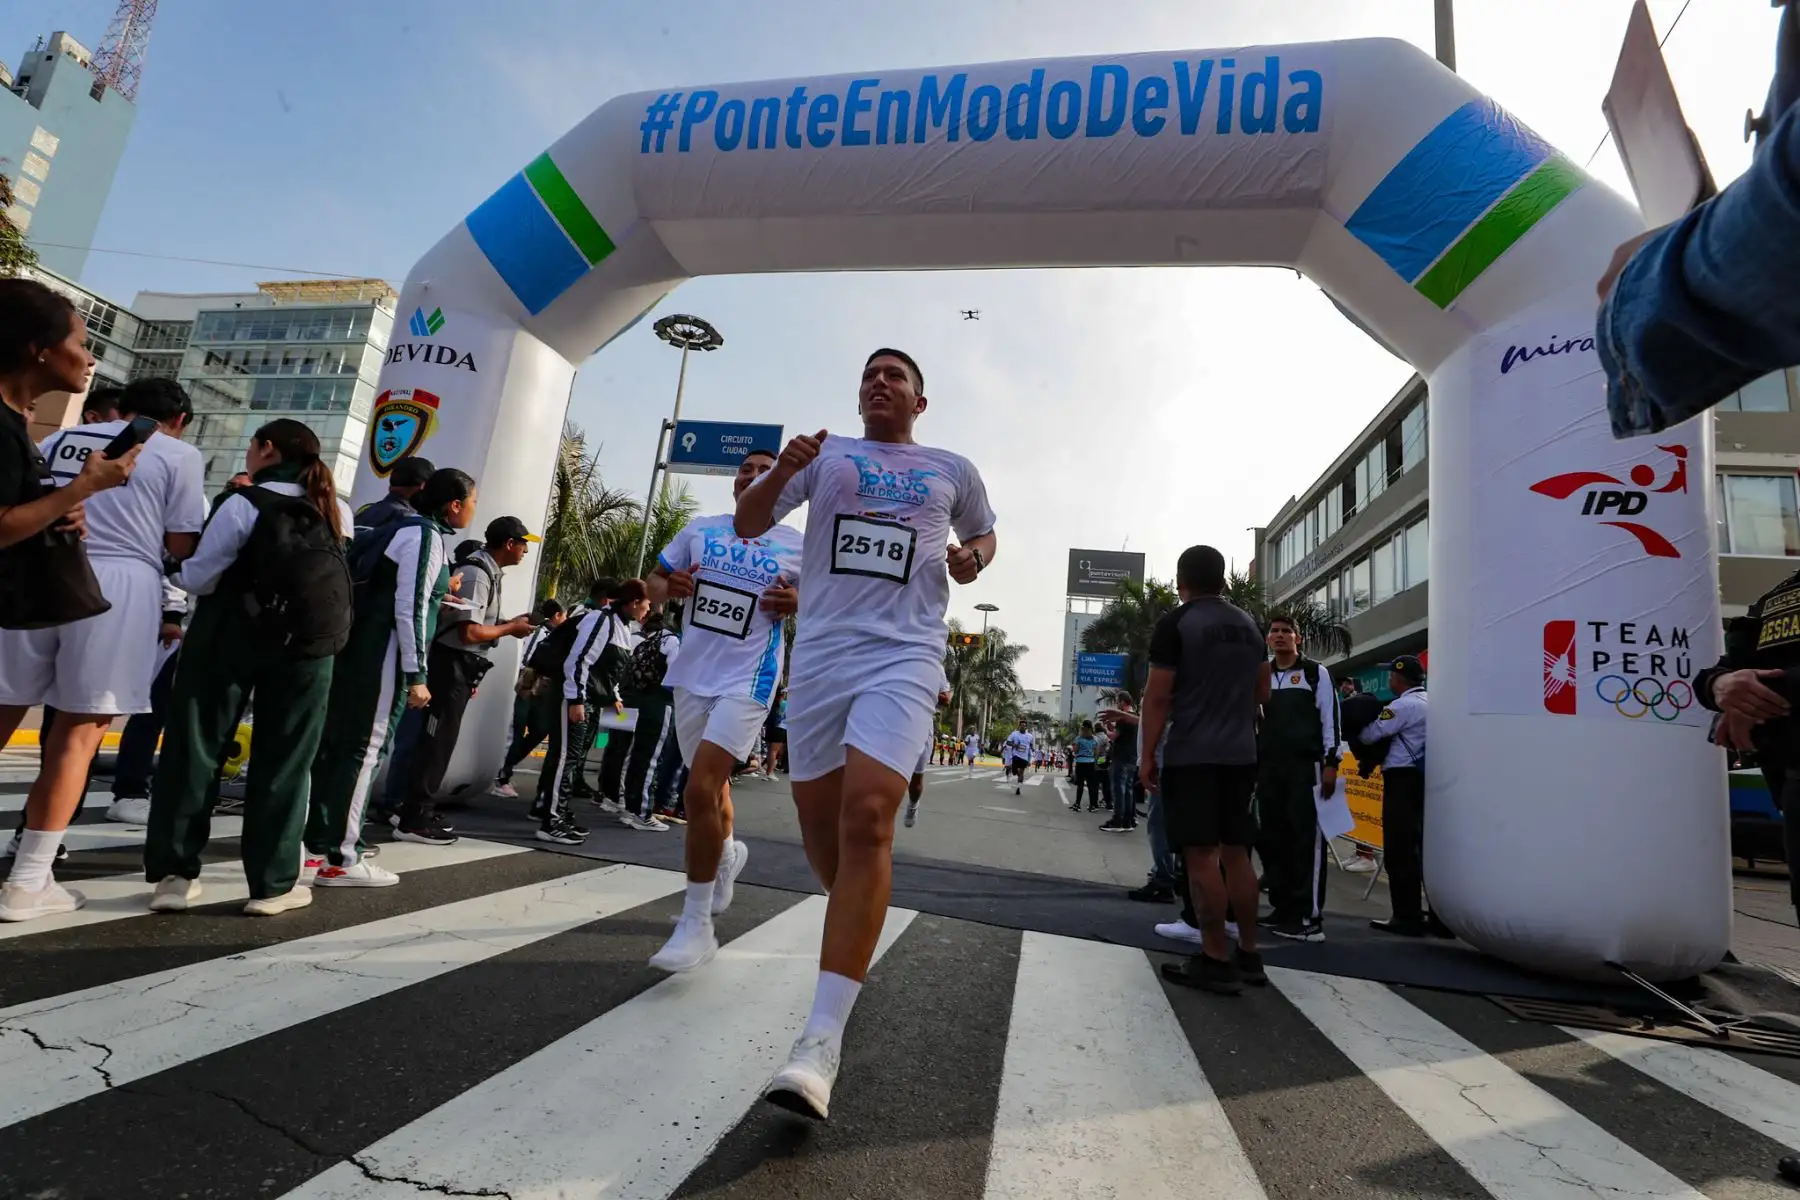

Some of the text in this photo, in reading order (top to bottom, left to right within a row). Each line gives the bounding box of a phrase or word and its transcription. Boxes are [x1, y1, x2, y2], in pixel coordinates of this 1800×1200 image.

[639, 56, 1323, 154] #PonteEnModoDeVida
[721, 435, 753, 445] CIRCUITO
[722, 446, 748, 455] CIUDAD
[858, 484, 925, 505] SIN DROGAS
[882, 471, 930, 496] VVO
[1581, 491, 1648, 515] IPD
[730, 543, 779, 574] VVO
[839, 534, 904, 561] 2518
[702, 555, 719, 570] SIN
[721, 561, 773, 585] DROGAS
[697, 596, 745, 622] 2526
[1588, 621, 1690, 650] TEAM
[1592, 651, 1691, 679] PERÚ
